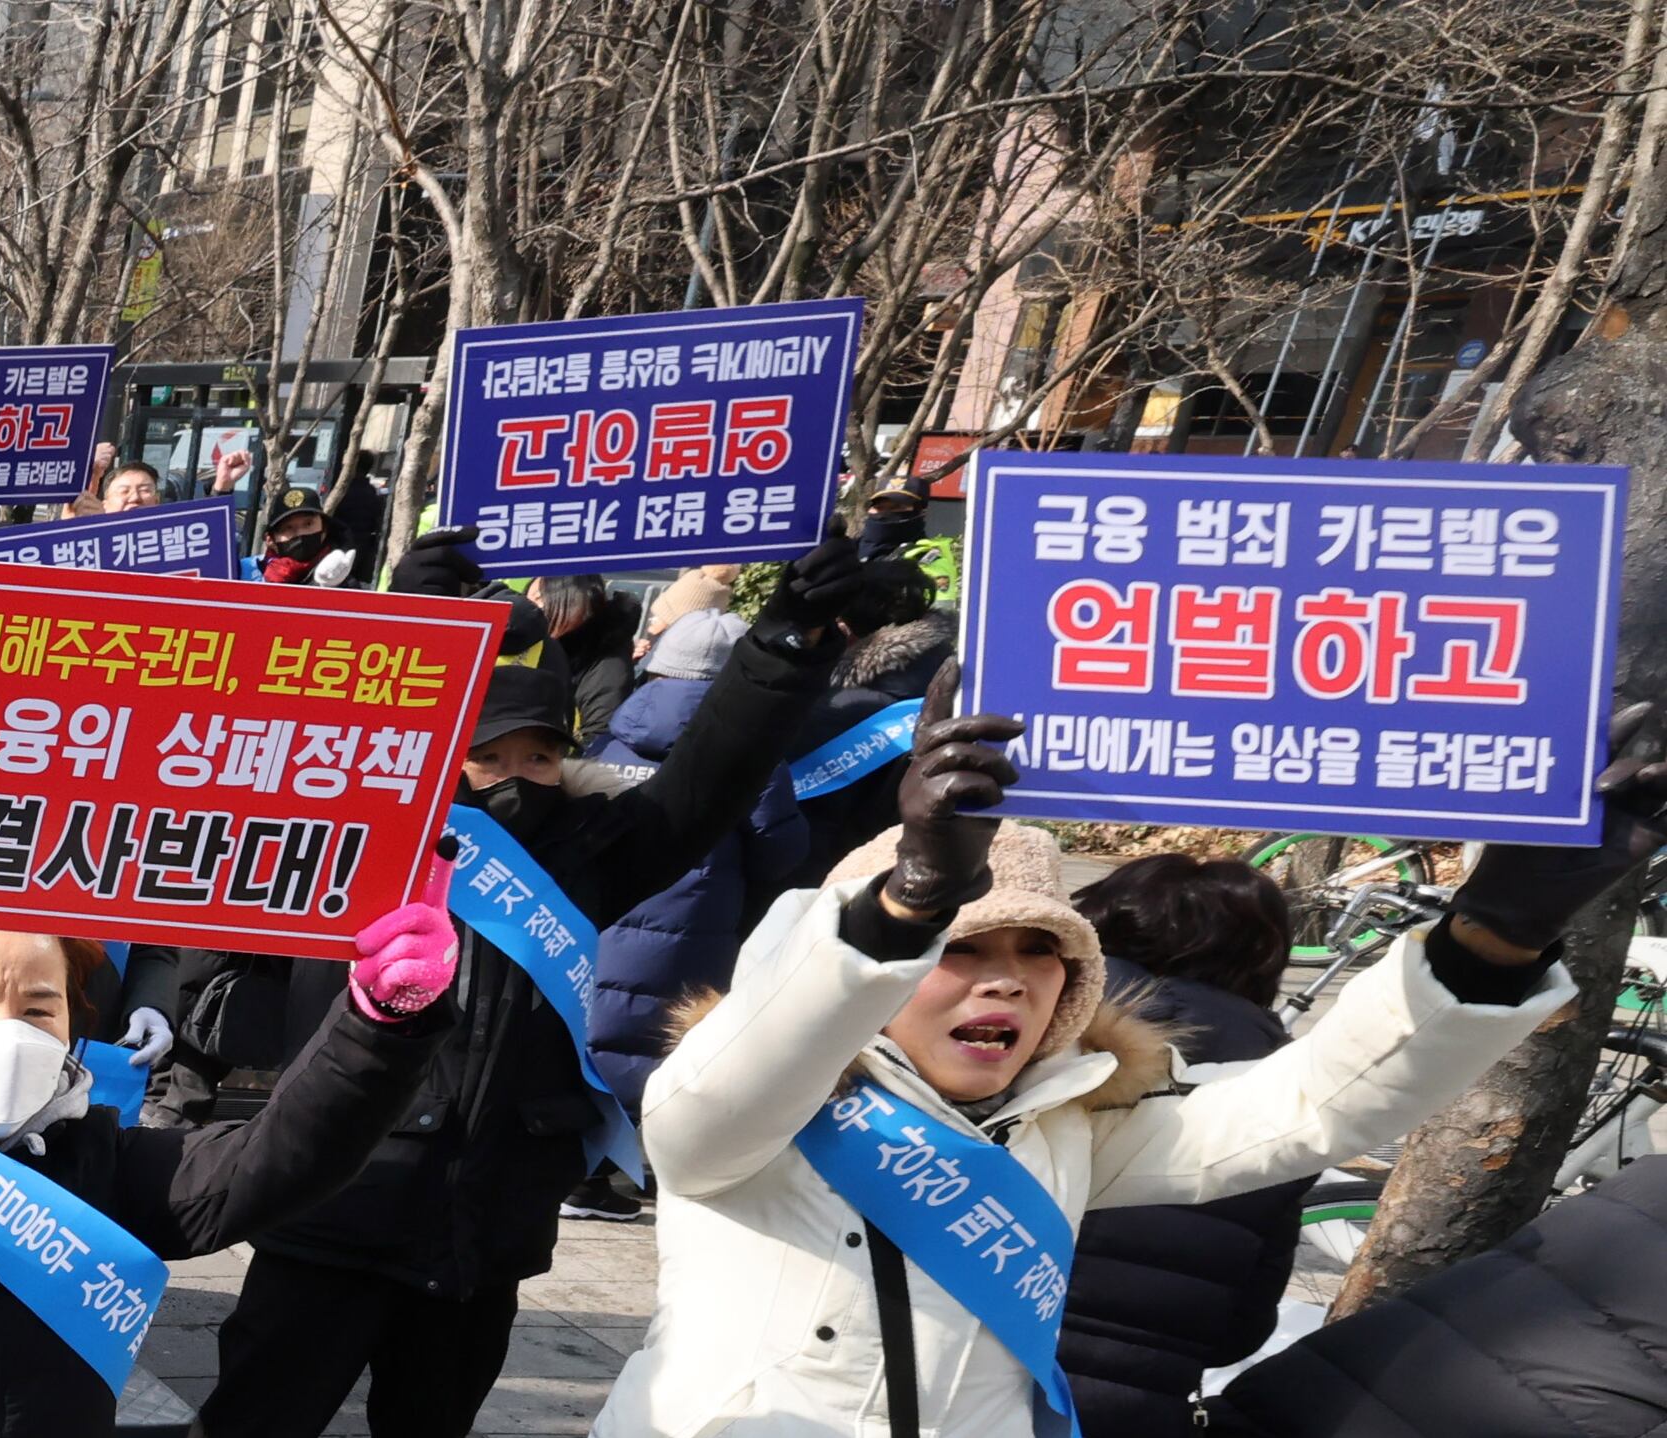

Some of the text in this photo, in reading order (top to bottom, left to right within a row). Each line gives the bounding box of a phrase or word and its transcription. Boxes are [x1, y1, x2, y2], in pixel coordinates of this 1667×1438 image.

[3, 364, 89, 396] 카르텔은
[482, 335, 832, 400] 시민에게는 일상을 돌려달라
[14, 460, 76, 486] 돌려달라
[495, 395, 793, 491] 엄벌하고
[112, 521, 210, 568] 카르텔은
[474, 485, 796, 552] 금융 범죄 카르텔은
[1032, 493, 1562, 578] 금융 범죄 카르텔은
[258, 635, 448, 708] 보호없는
[1046, 577, 1528, 706] 엄벌하고
[157, 711, 433, 805] 상폐정책
[1007, 714, 1555, 796] 시민에게는 일상을 돌려달라
[469, 857, 577, 959] 폐지 정책
[877, 1125, 971, 1208] 상장
[945, 1195, 1037, 1274] 폐지
[80, 1261, 148, 1335] 상장
